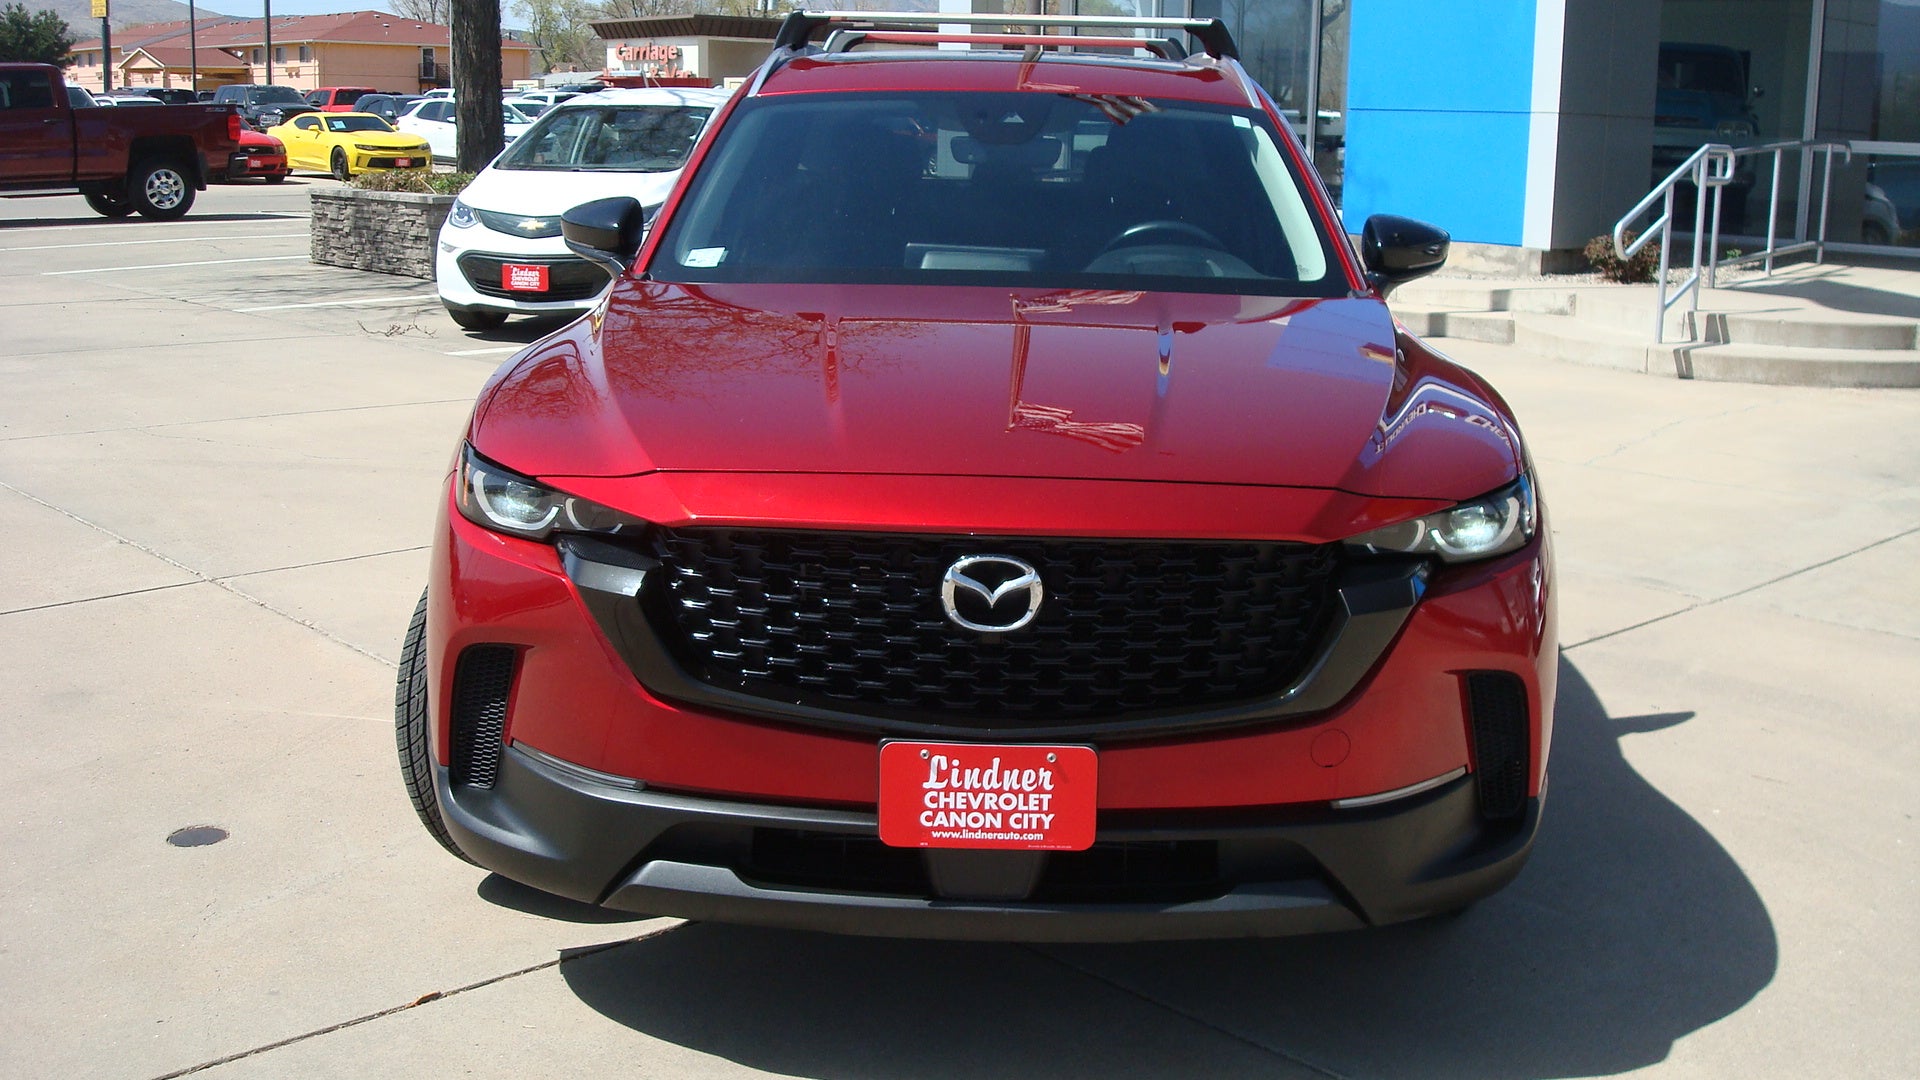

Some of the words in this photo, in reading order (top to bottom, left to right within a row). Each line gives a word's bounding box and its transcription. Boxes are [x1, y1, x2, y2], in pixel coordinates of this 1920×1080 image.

[615, 42, 678, 65] Carriage
[922, 755, 1054, 792] Lindner
[924, 791, 1053, 811] CHEVROLET
[919, 810, 1003, 829] CANON
[1009, 813, 1055, 830] CITY
[931, 829, 1044, 841] www.lindnerauto.com
